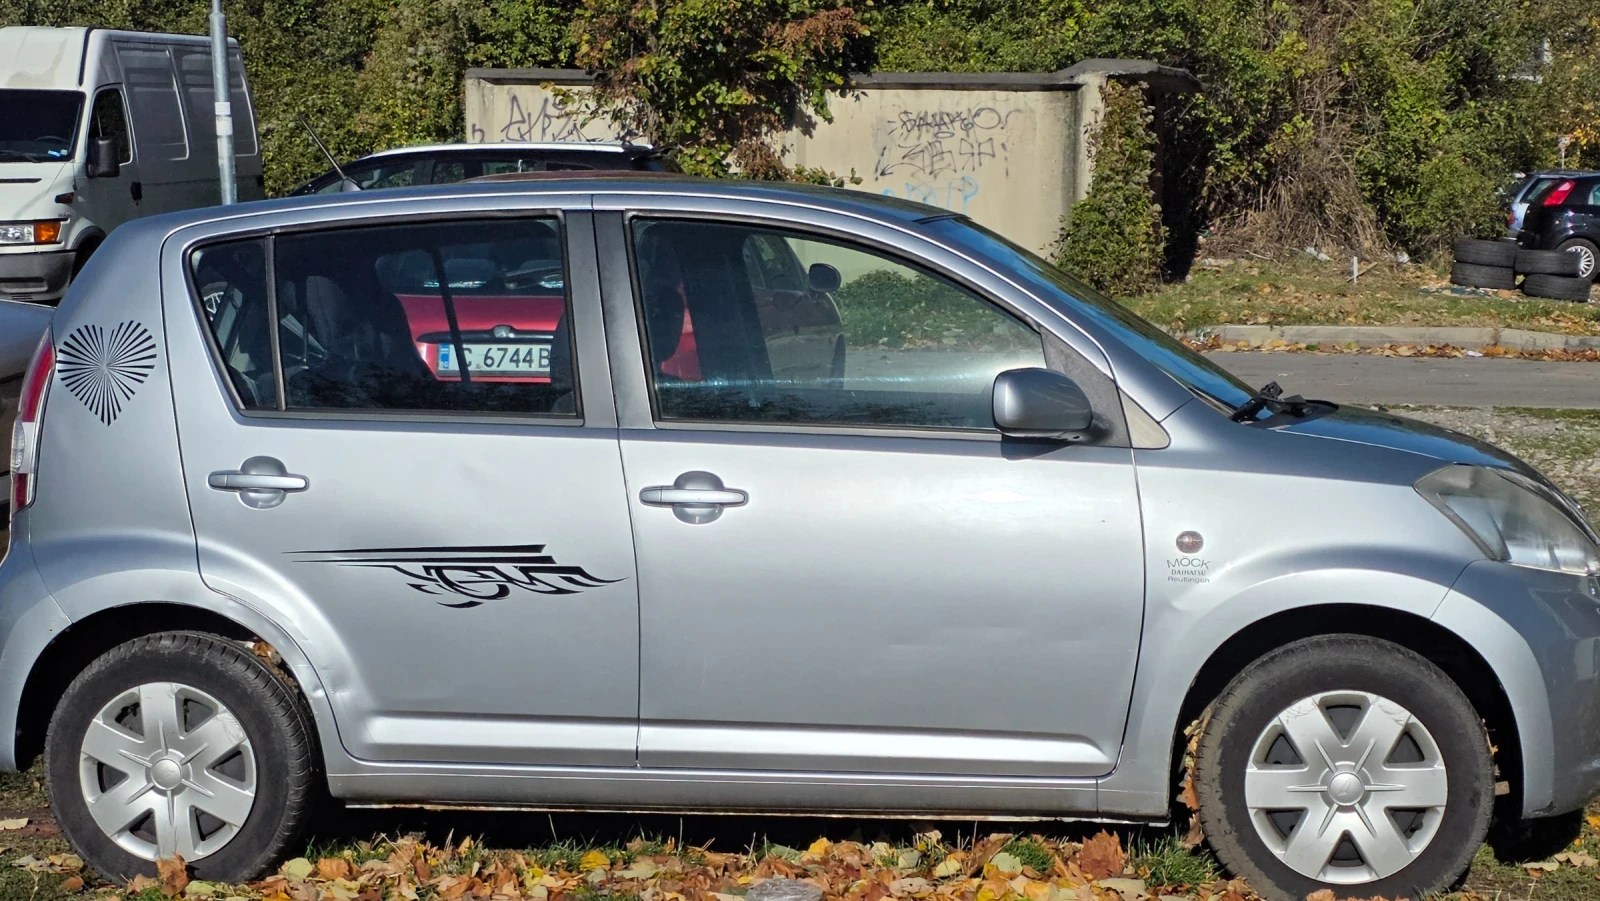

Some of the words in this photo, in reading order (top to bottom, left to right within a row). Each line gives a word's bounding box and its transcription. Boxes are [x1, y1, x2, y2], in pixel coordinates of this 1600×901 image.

[483, 347, 535, 368] 6744
[1166, 555, 1212, 570] MÖCK
[1171, 569, 1207, 577] DAIHATSU
[1167, 576, 1210, 584] Reutlingen
